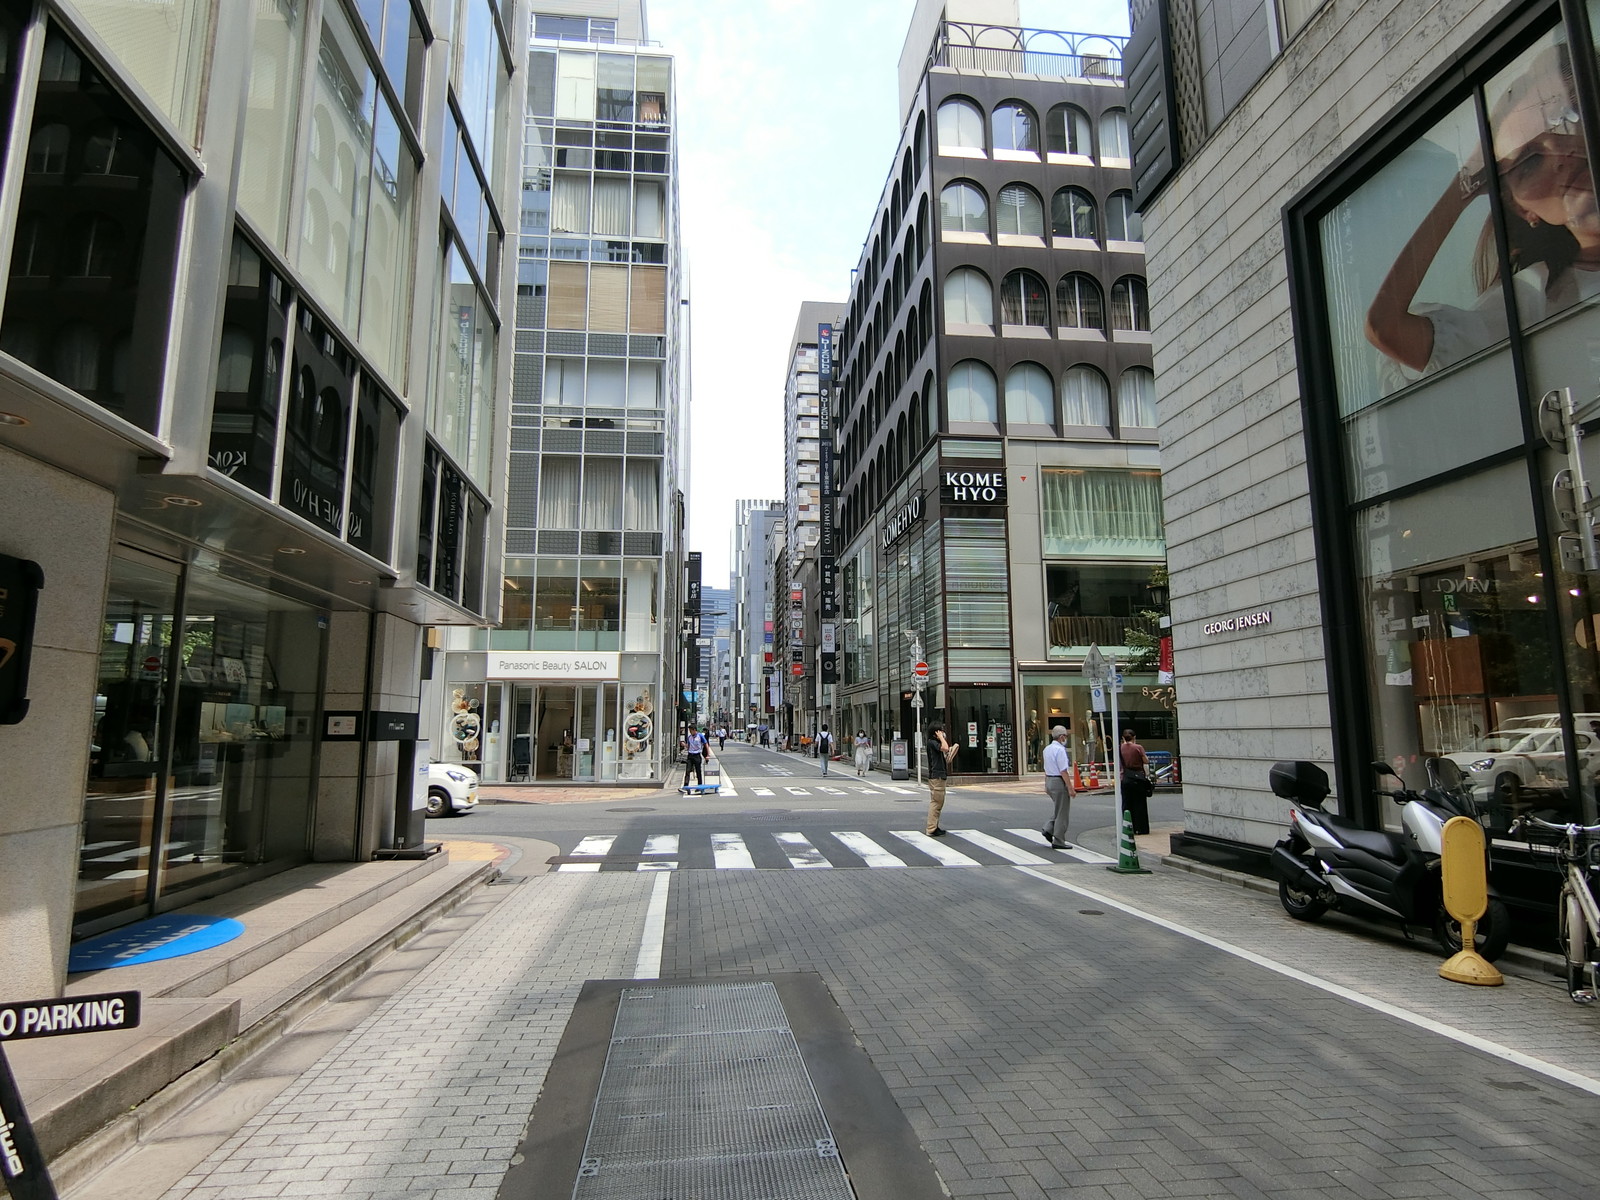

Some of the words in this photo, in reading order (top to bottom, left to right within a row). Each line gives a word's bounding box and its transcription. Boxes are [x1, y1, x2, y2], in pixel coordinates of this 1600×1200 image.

[945, 472, 1003, 487] KOME
[953, 487, 997, 501] HYO
[823, 503, 831, 545] KOMEHYO
[882, 496, 919, 550] KOMEHYO
[1203, 618, 1235, 635] GEORG
[1236, 611, 1271, 631] JENSEN
[499, 660, 540, 671] Panasonic
[543, 660, 571, 673] Beauty
[574, 661, 607, 671] SALON
[0, 1008, 17, 1036] O
[21, 998, 125, 1034] PARKING
